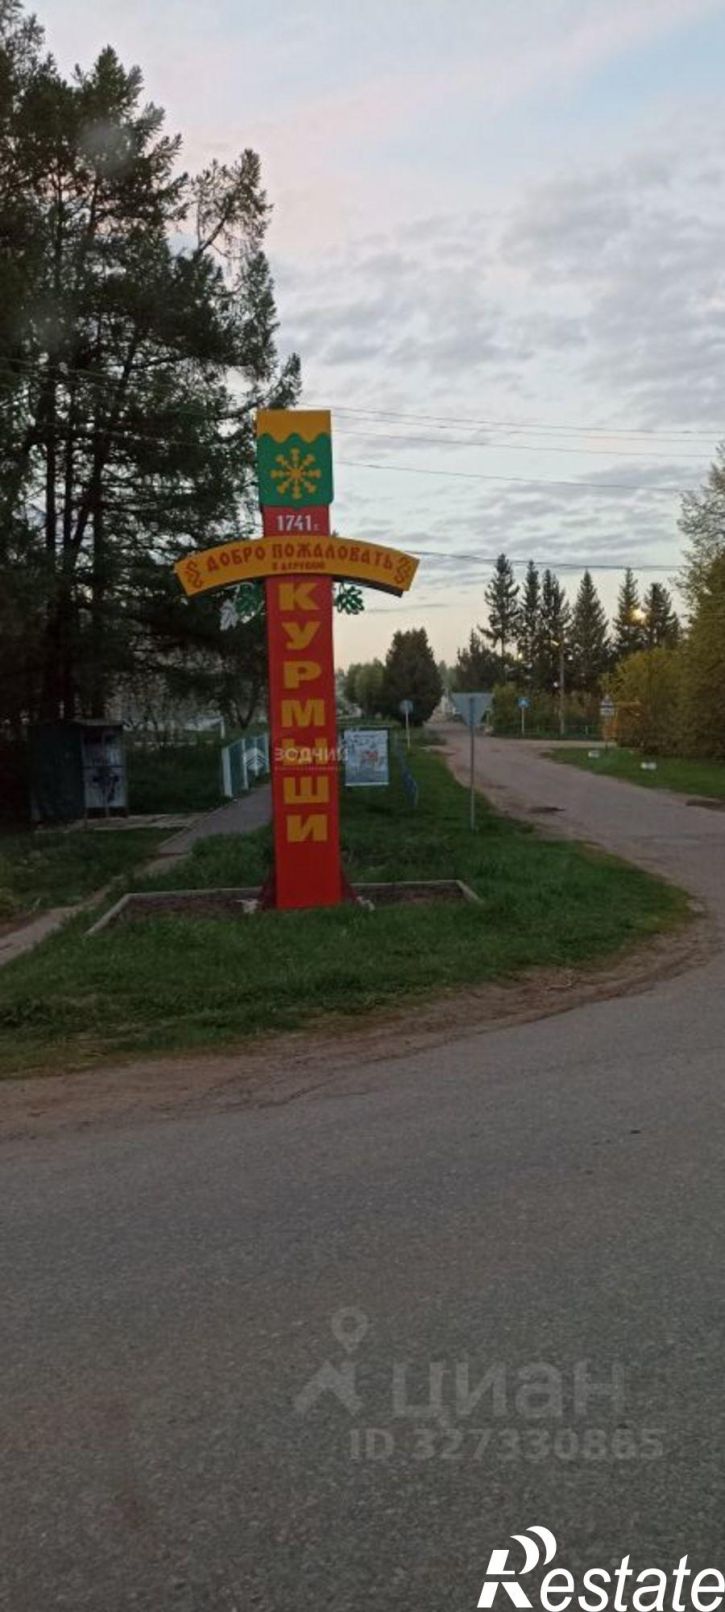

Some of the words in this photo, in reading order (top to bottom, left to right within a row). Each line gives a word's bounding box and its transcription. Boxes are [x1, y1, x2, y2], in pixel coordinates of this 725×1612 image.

[206, 546, 266, 573] ДОБРО
[272, 542, 393, 570] ПОЖАЛОВАТЬ
[277, 582, 330, 843] КУРМЫШИ
